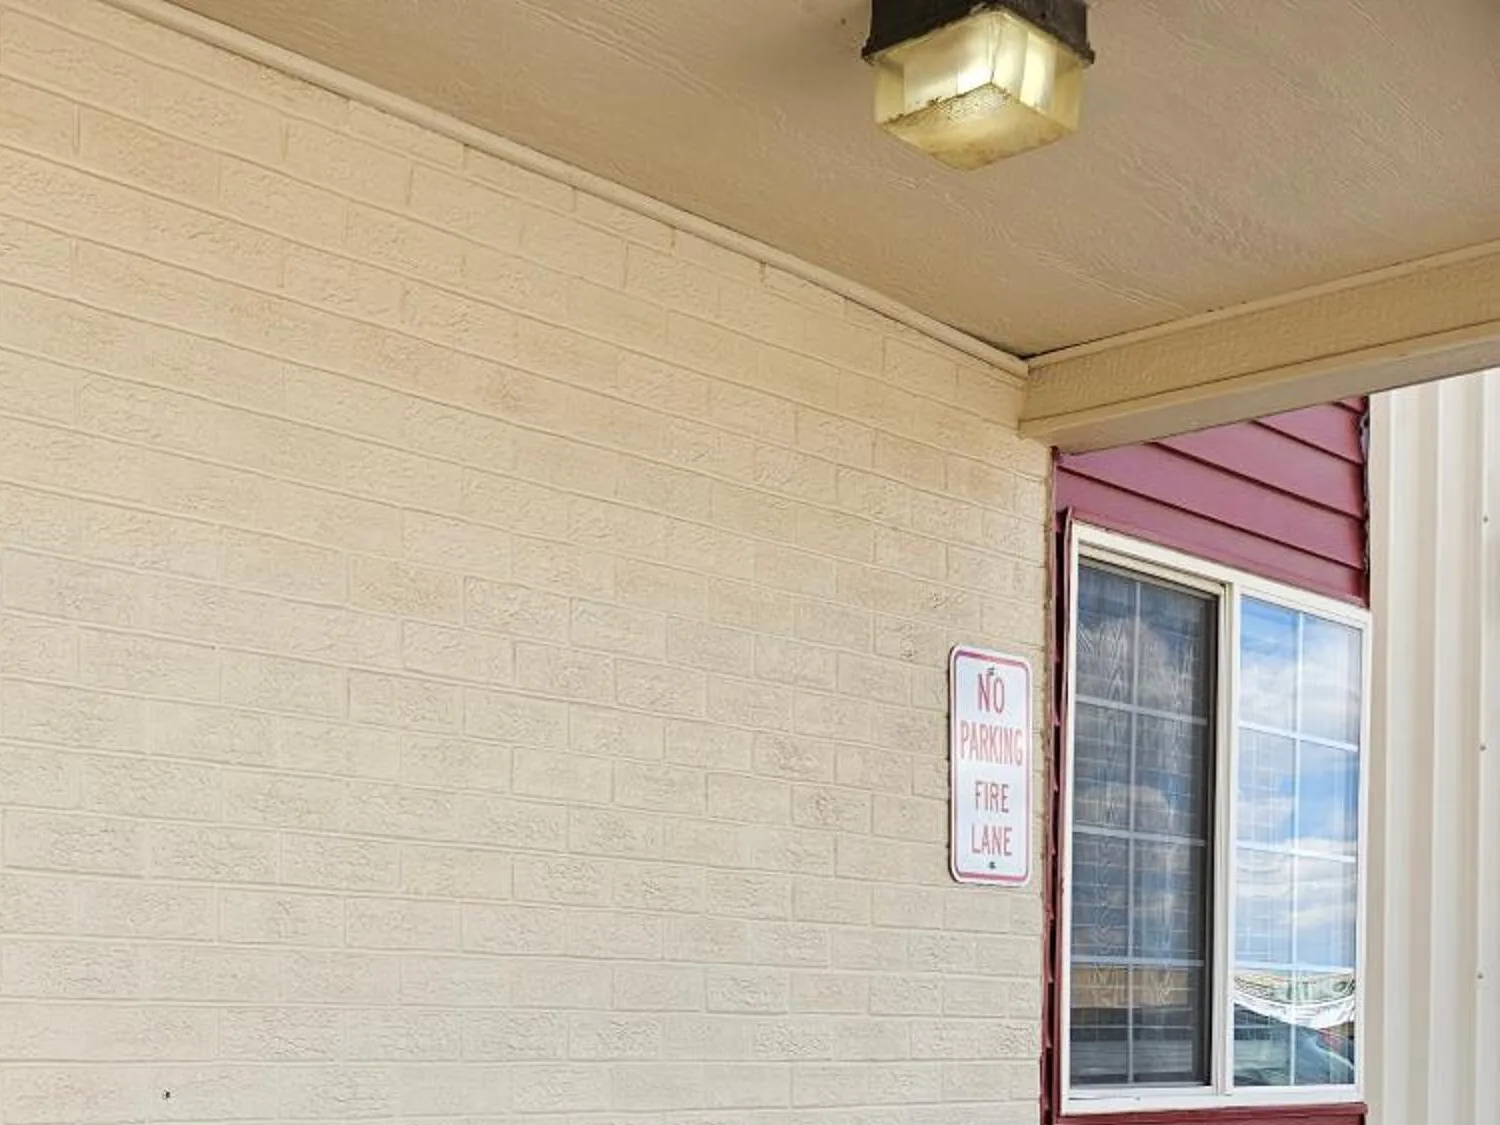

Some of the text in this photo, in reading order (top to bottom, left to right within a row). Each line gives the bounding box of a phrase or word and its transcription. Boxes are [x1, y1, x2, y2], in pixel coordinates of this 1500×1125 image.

[977, 672, 1006, 713] NO
[959, 719, 1023, 766] PARKING
[974, 780, 1010, 814] FIRE
[971, 823, 1013, 857] LANE
